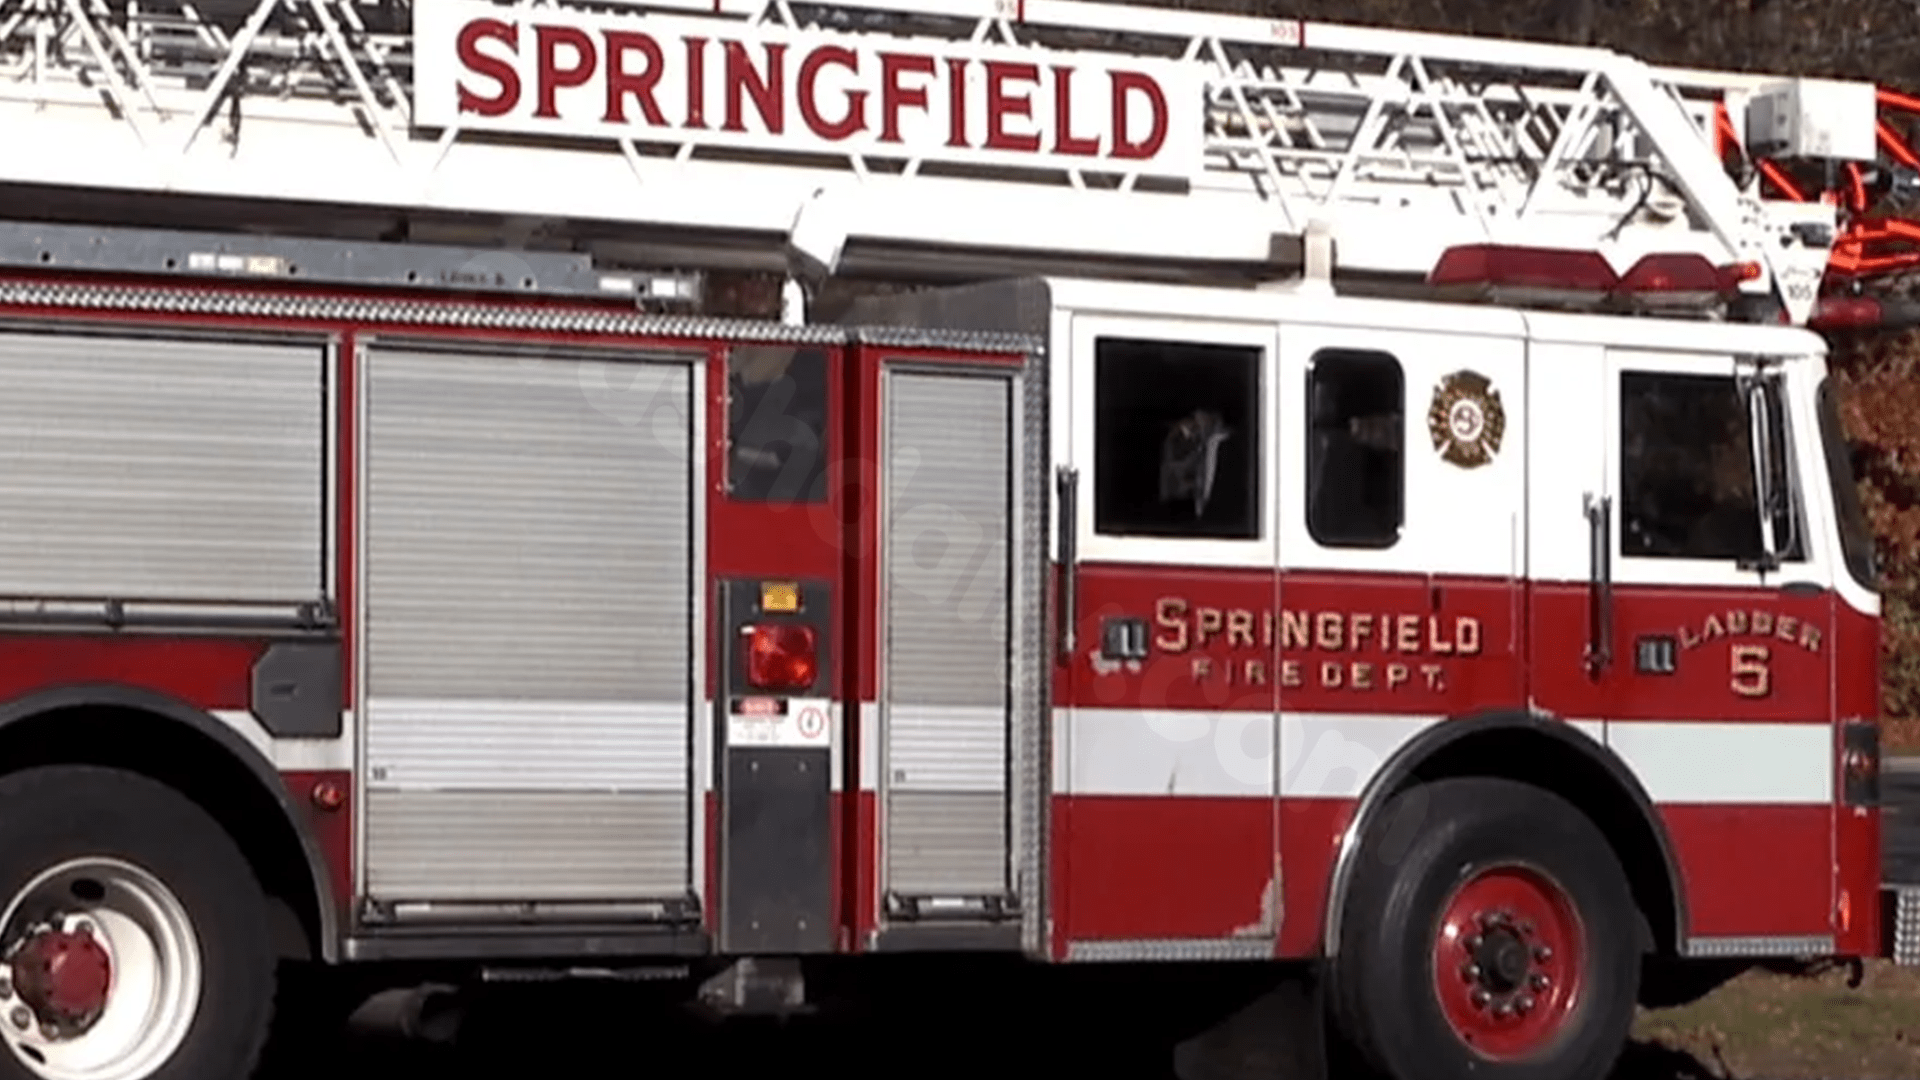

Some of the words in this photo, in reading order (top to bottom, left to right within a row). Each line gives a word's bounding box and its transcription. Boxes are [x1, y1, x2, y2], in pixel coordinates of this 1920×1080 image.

[455, 18, 1169, 161] SPRINGFIELD
[1155, 597, 1482, 655] SPRINGFIELD
[1677, 609, 1822, 652] LADDER
[1192, 658, 1303, 688] FIRE
[1320, 660, 1448, 692] DEPT.
[1730, 643, 1770, 697] 5
